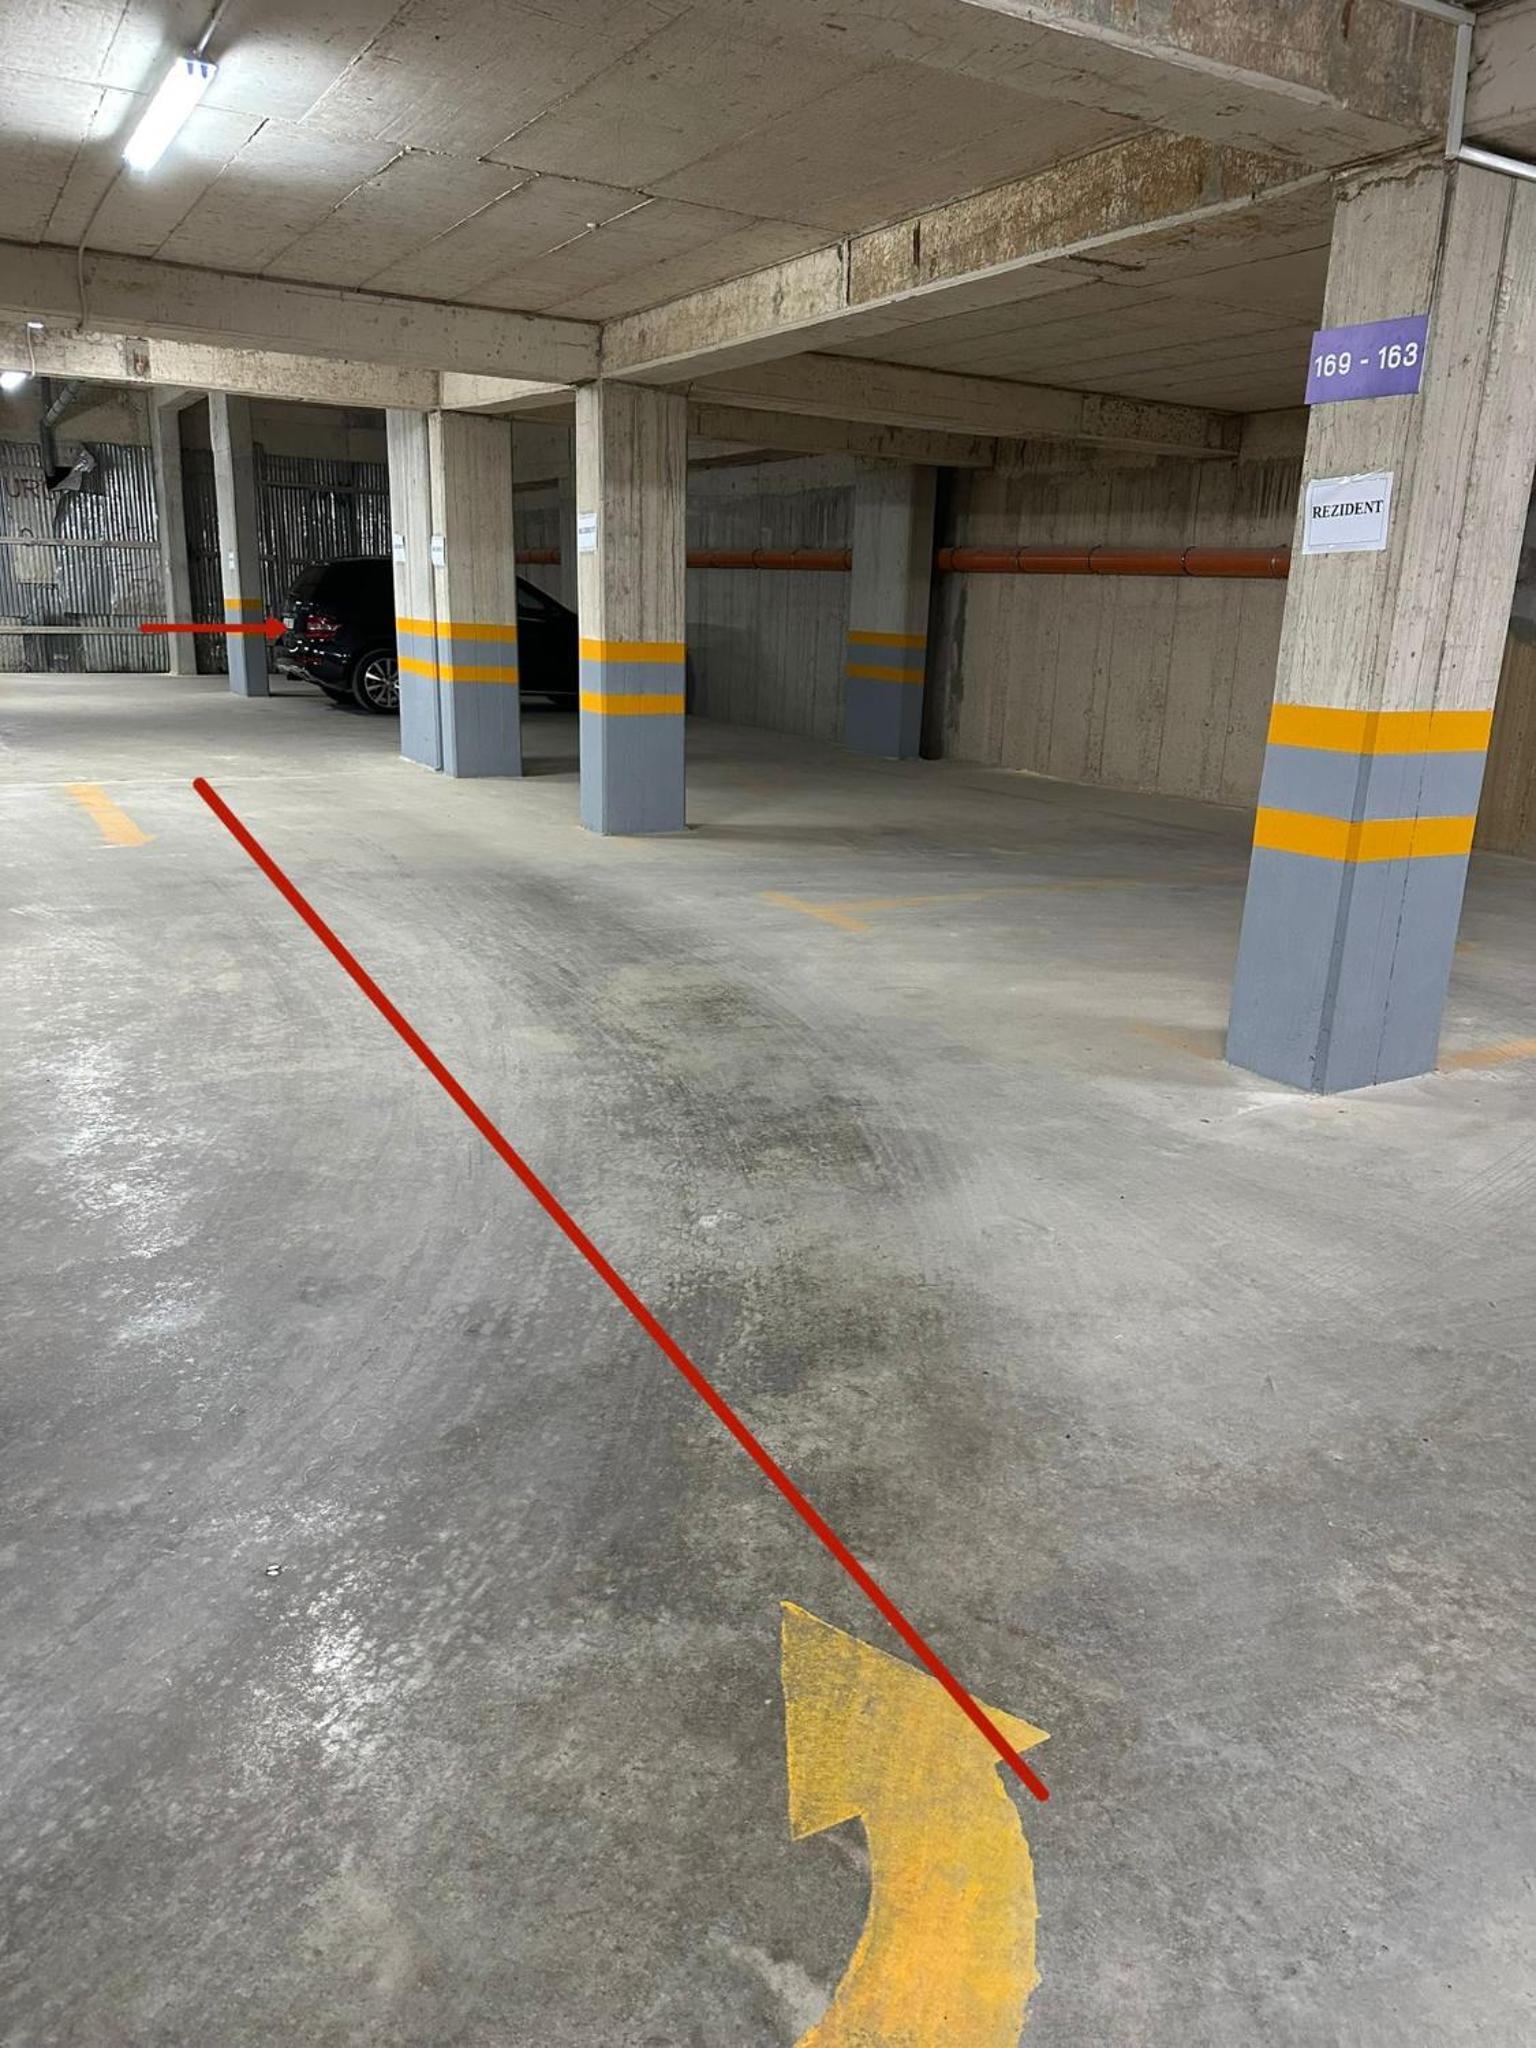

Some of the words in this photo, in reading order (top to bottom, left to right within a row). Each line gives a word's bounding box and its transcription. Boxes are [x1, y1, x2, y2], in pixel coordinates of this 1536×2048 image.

[1314, 352, 1351, 378] 169
[1378, 342, 1418, 370] 163
[1312, 499, 1384, 519] REZIDENT
